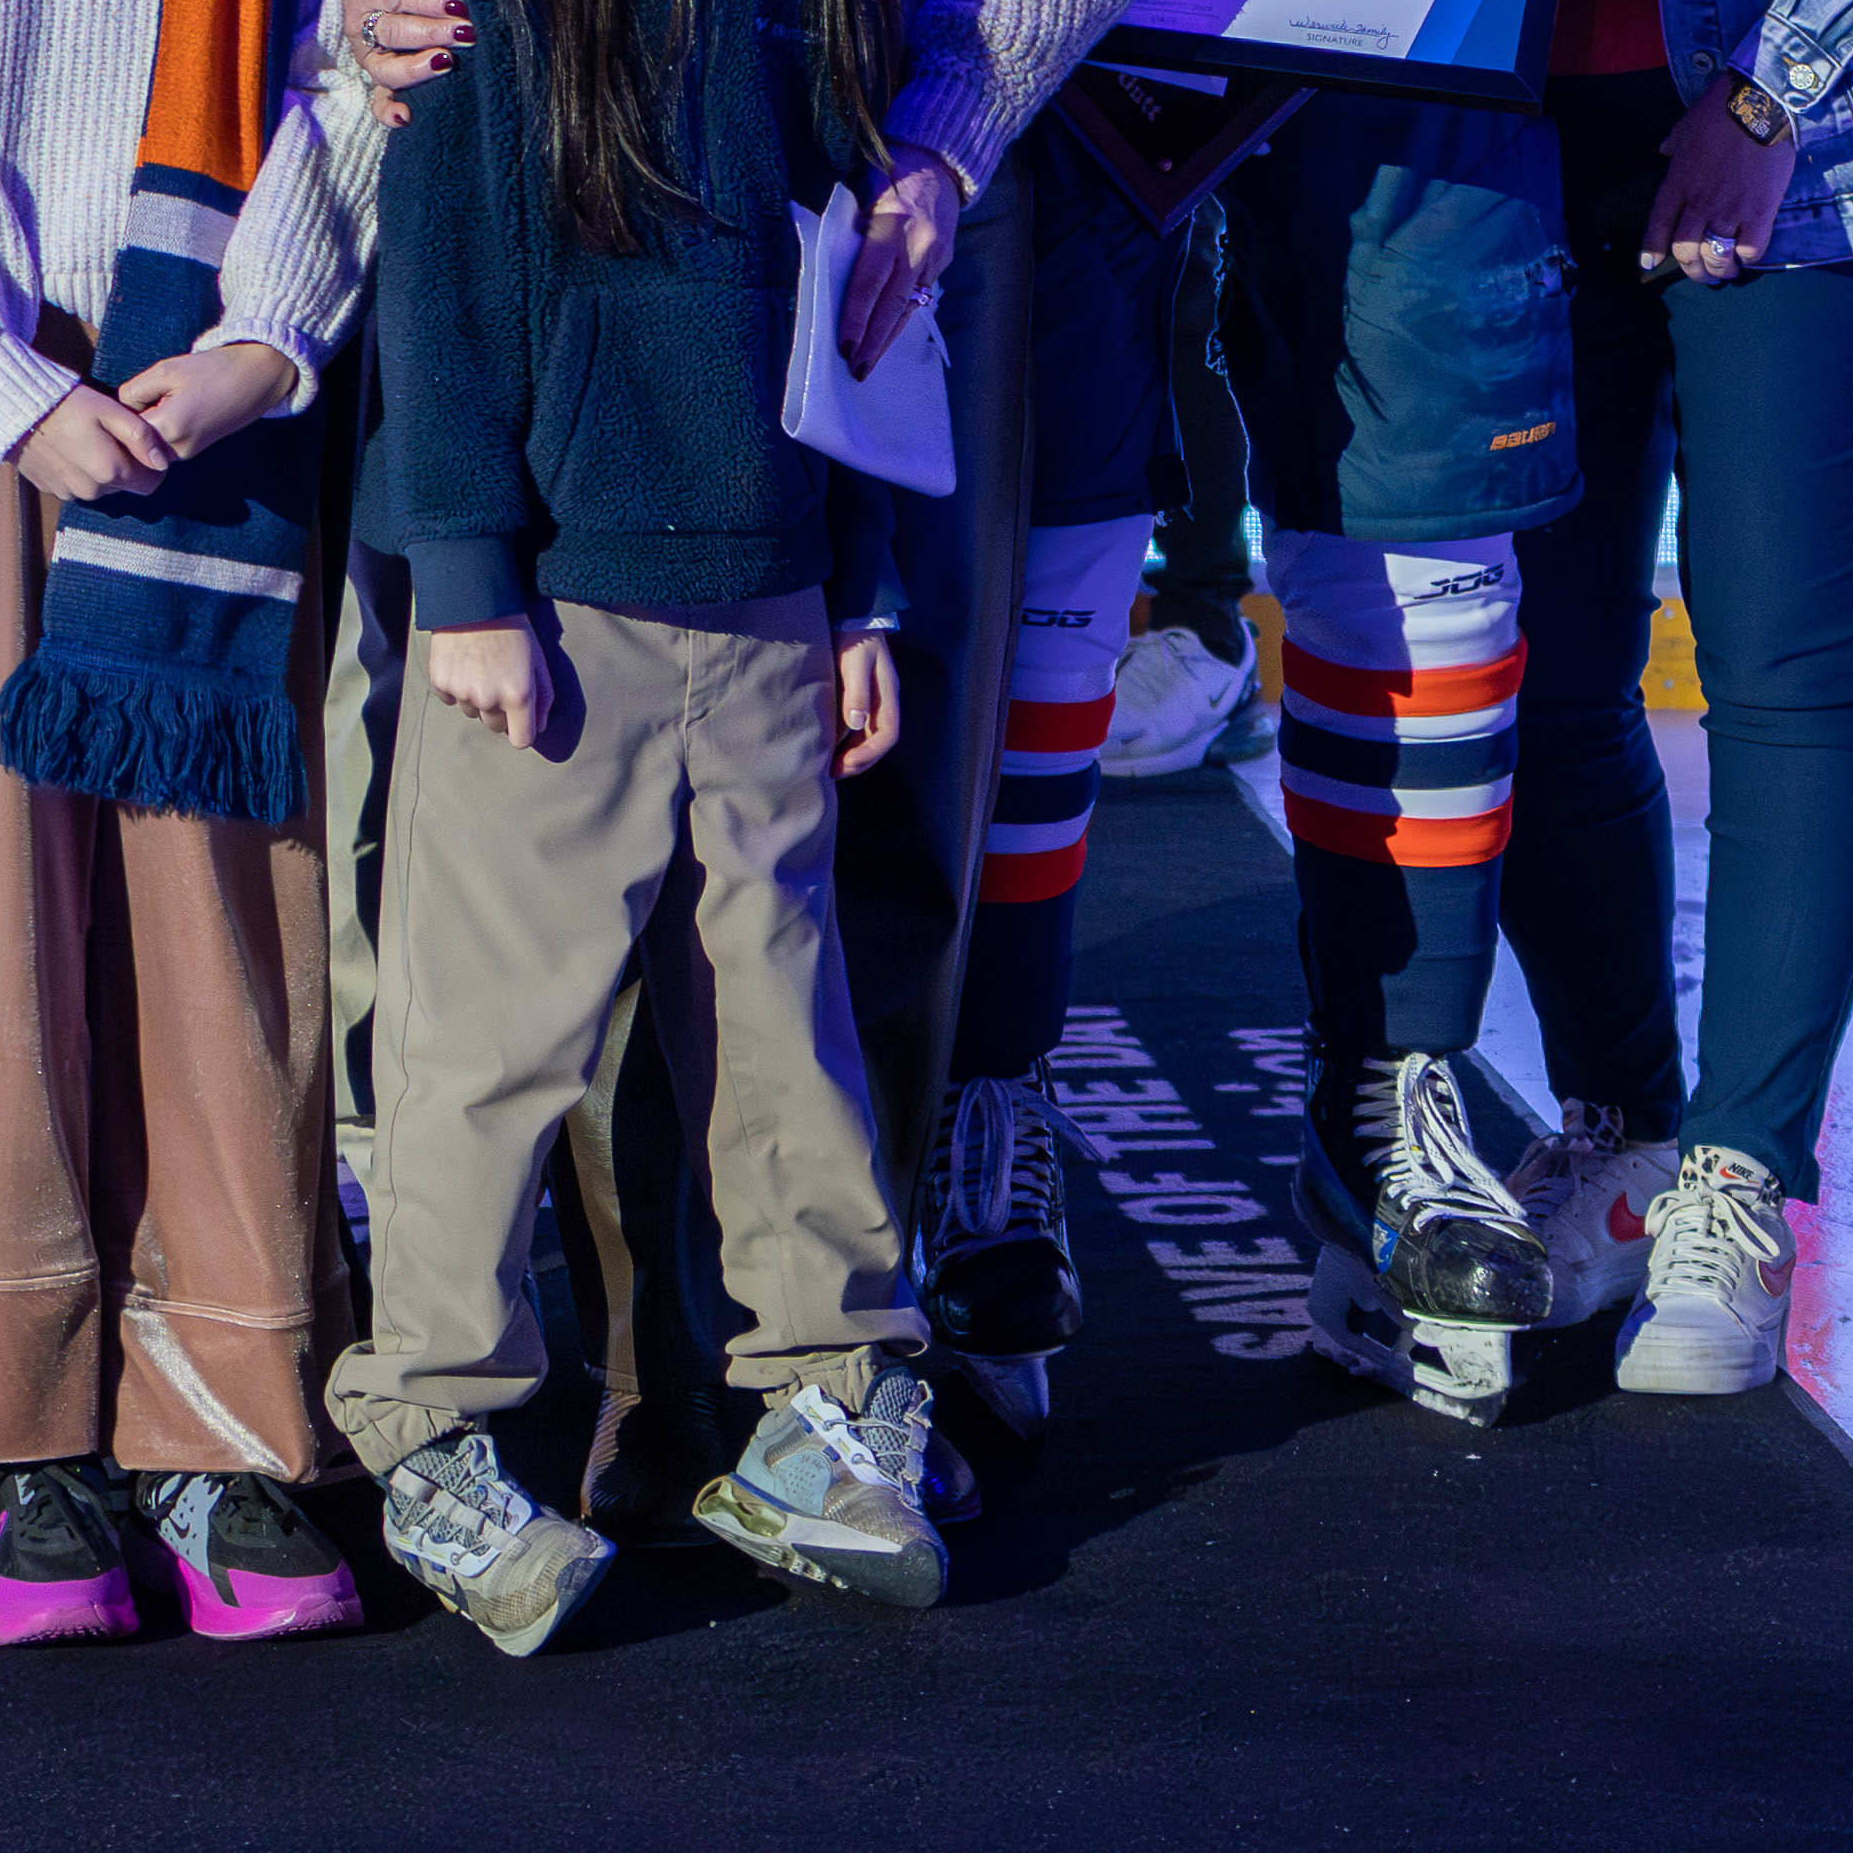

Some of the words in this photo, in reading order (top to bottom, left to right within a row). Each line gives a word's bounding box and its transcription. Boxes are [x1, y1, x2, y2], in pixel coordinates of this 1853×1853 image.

[1306, 32, 1364, 47] SIGNATURE
[1050, 1079, 1216, 1150] THE
[1728, 1161, 1755, 1180] NIKE
[1098, 1171, 1268, 1225] OF
[1147, 1236, 1313, 1360] SAVE
